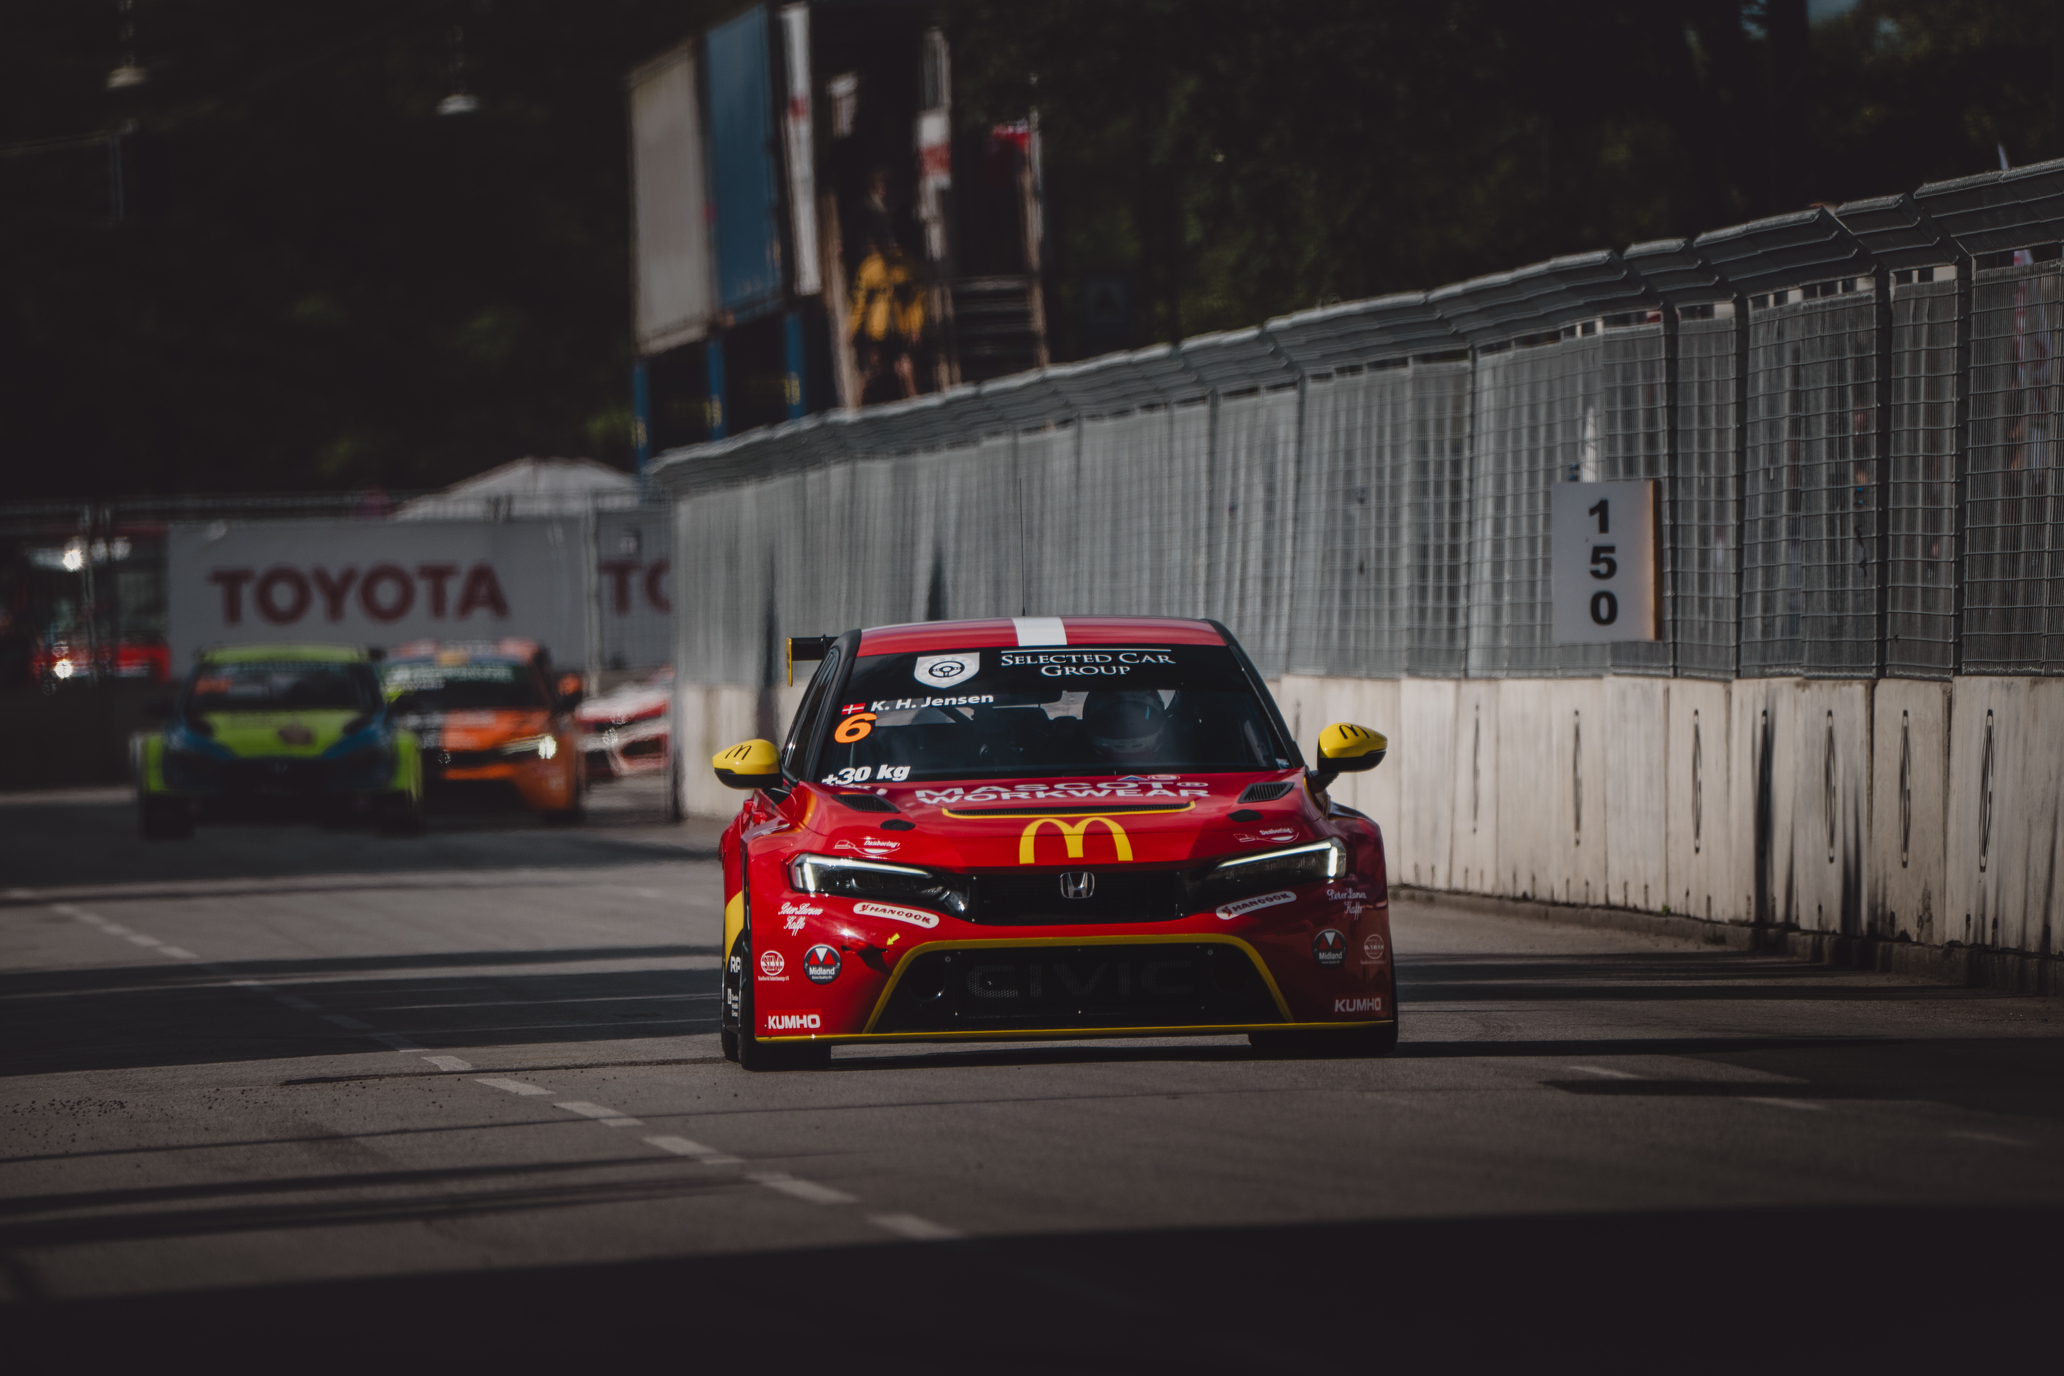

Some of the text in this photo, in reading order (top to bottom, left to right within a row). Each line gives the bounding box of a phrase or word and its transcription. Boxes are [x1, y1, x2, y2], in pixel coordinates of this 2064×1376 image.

[1589, 499, 1618, 626] 150
[209, 561, 511, 626] TOYOTA
[1001, 652, 1176, 667] SELECTED CAR
[1041, 665, 1131, 677] GROUP
[870, 694, 994, 712] K. H. Jensen
[834, 712, 877, 744] 6
[821, 764, 911, 786] +30 kg
[917, 789, 1210, 804] WORKWEAR
[1232, 893, 1291, 912] HANCOCK
[871, 905, 931, 925] HANCOCK
[1319, 951, 1343, 960] Midland
[809, 966, 835, 976] Midland
[966, 960, 1194, 998] CIVIC
[1335, 998, 1382, 1013] KUMHO
[768, 1013, 821, 1030] KUMHO
